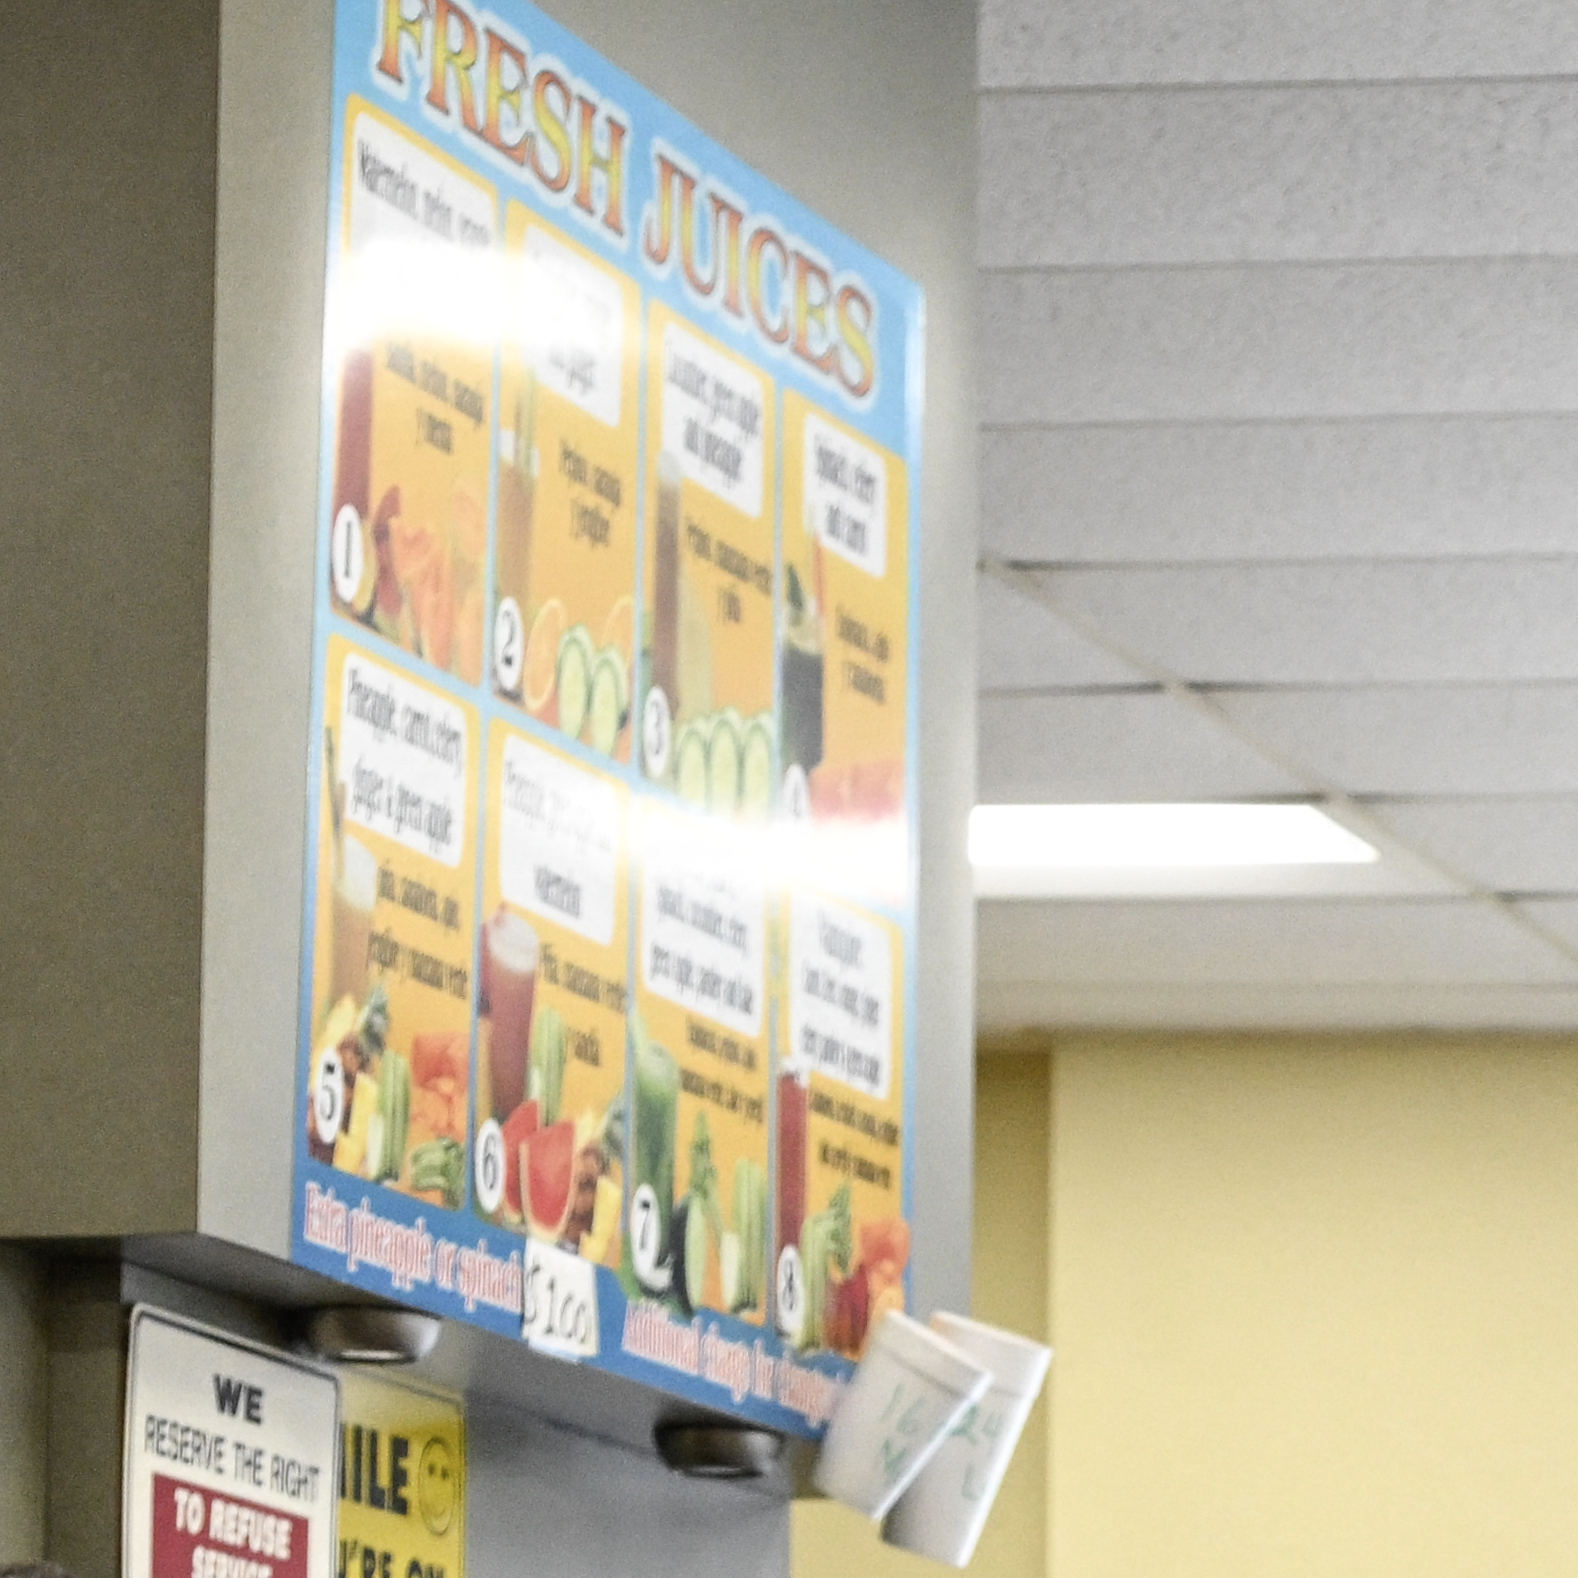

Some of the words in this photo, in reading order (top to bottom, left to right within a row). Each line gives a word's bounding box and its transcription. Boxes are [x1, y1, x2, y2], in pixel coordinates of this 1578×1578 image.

[376, 0, 627, 239] FRESH
[641, 151, 875, 398] JUICES
[344, 520, 353, 579] 1
[502, 608, 516, 668] 2
[651, 699, 663, 757] 3
[319, 1062, 336, 1122] 5
[483, 1131, 497, 1191] 6
[304, 1181, 348, 1253] Extra
[348, 1196, 433, 1292] pineapple
[434, 1237, 458, 1291] or
[457, 1238, 524, 1314] spinach
[638, 1198, 651, 1251] 7
[782, 1258, 795, 1312] 8
[213, 1373, 264, 1426] WE
[145, 1413, 226, 1475] RESERVE
[233, 1441, 265, 1488] THE
[270, 1454, 320, 1503] RIGHT
[340, 1424, 411, 1517] ILE
[174, 1487, 205, 1536] TO
[209, 1499, 293, 1562] REFUSE
